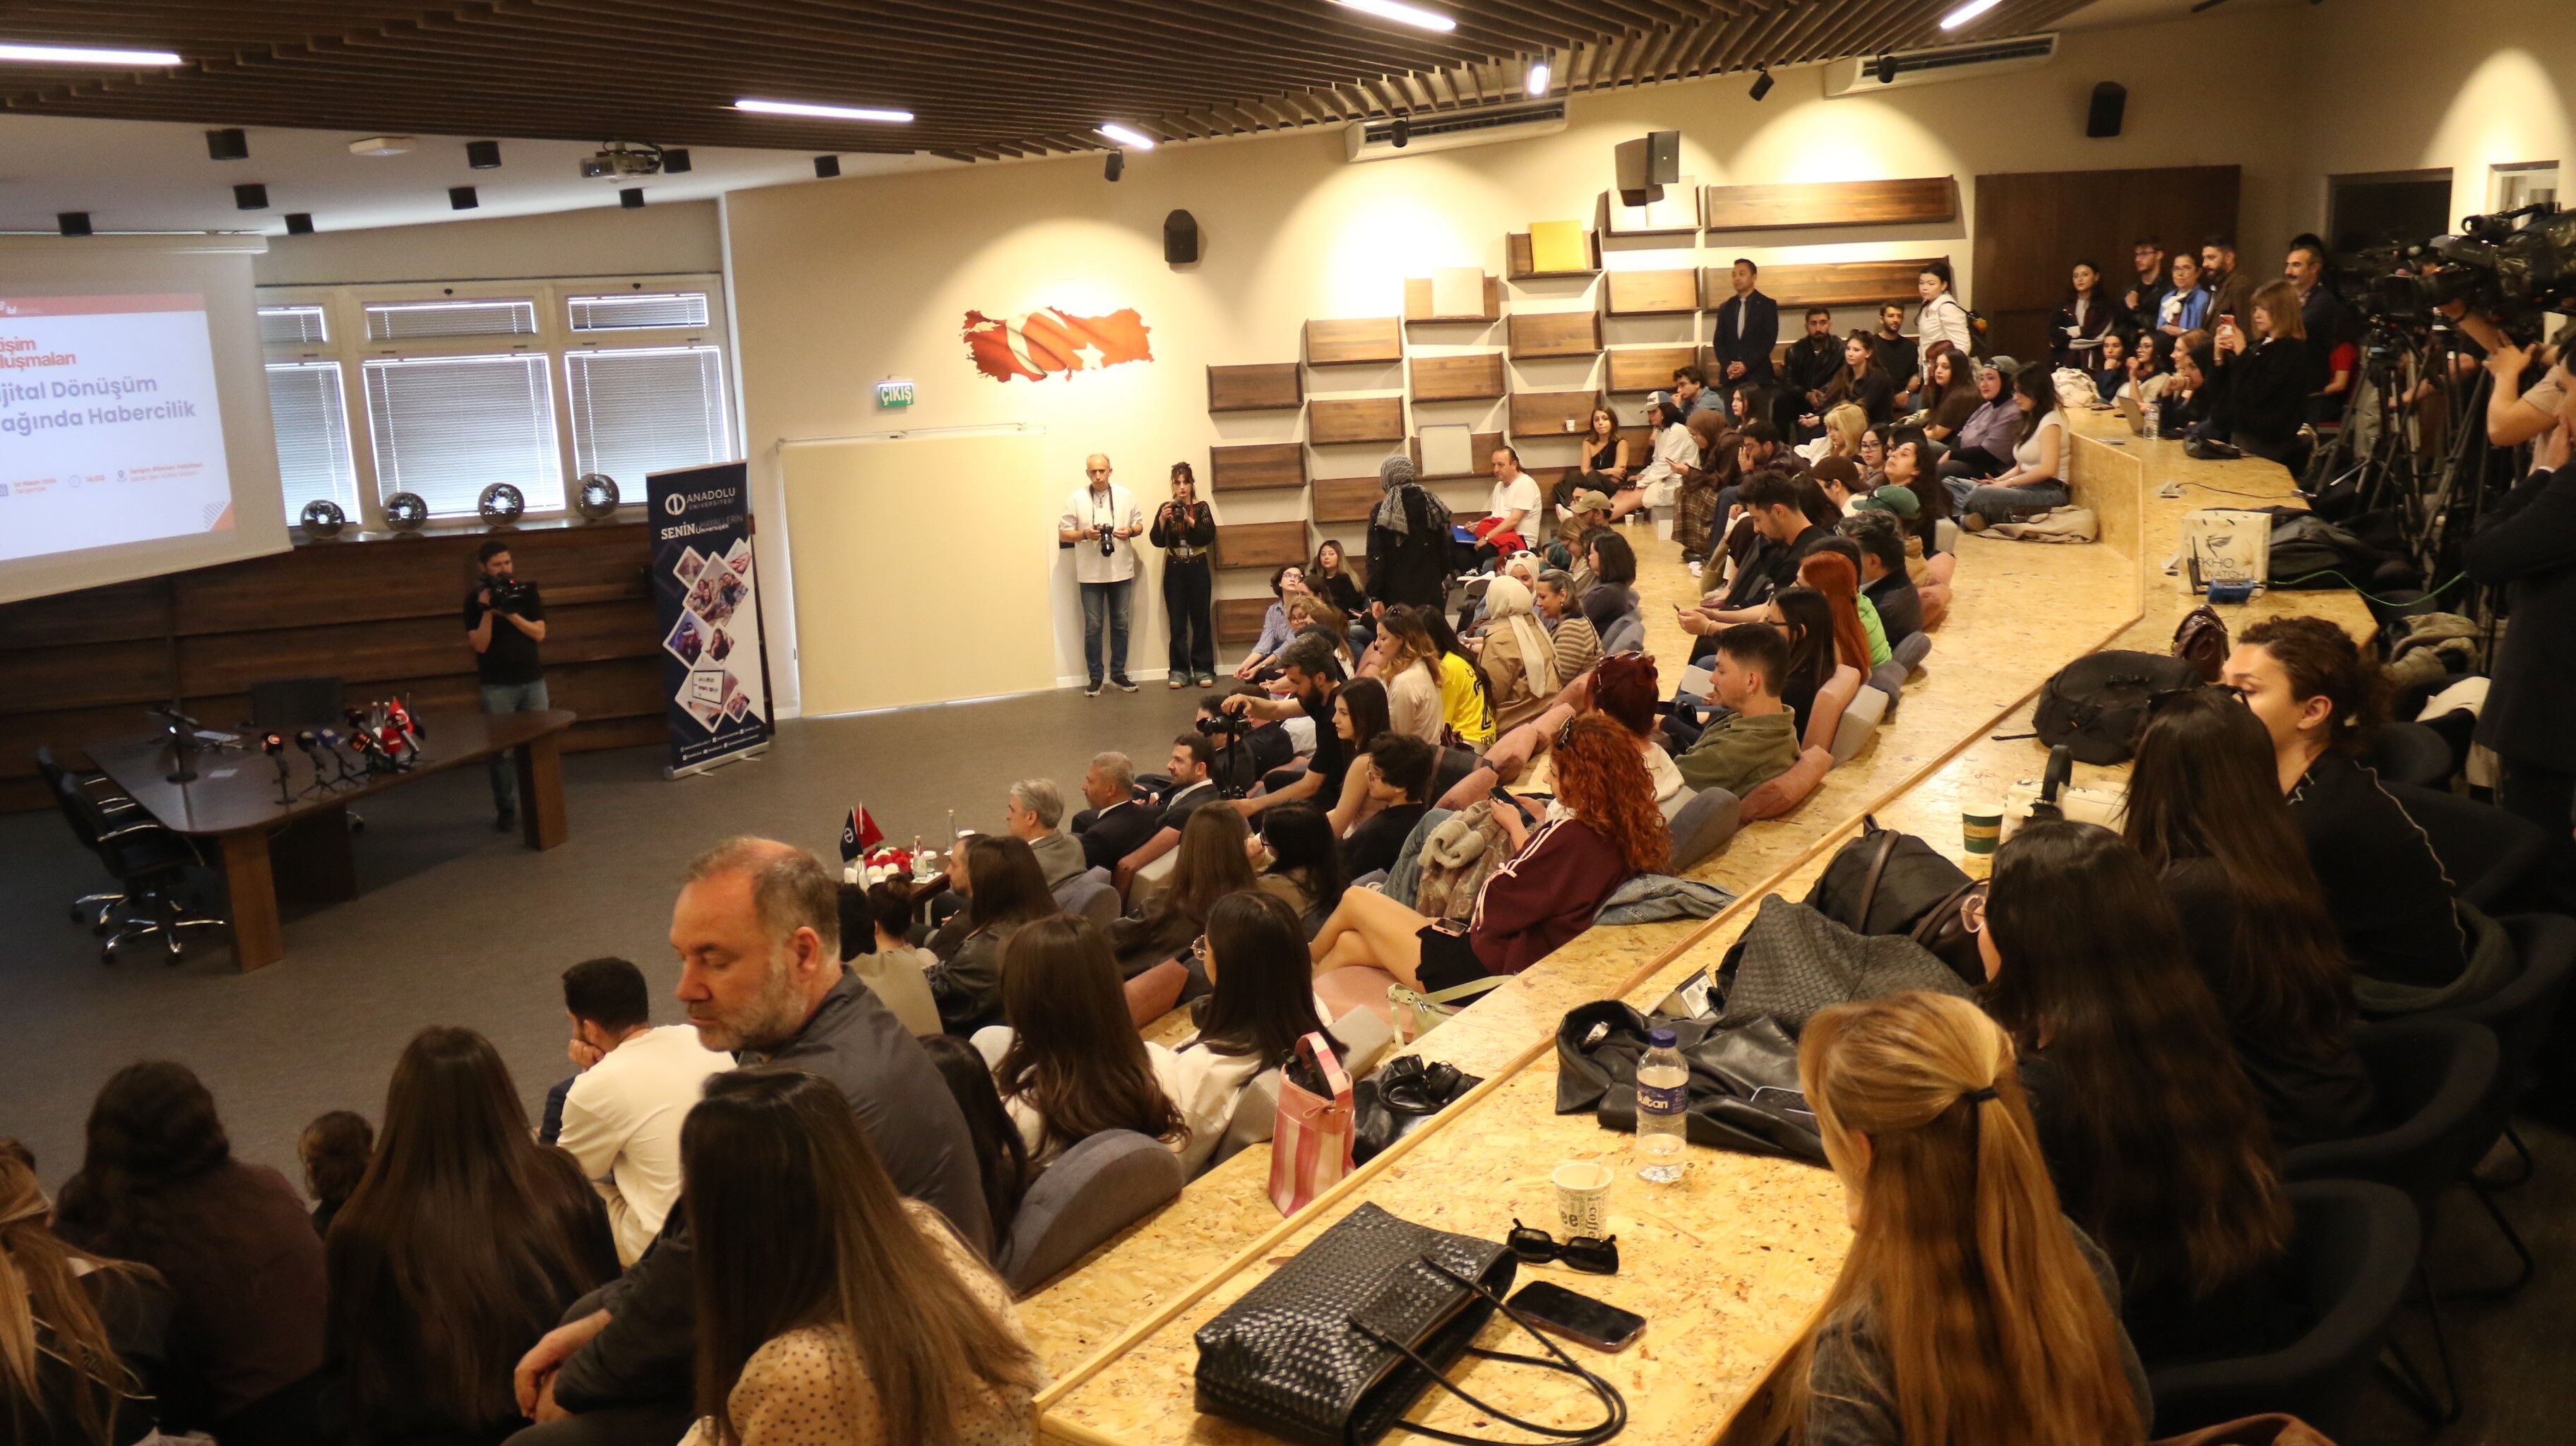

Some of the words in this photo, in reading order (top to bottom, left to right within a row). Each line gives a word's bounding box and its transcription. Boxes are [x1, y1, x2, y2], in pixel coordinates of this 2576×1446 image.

[0, 382, 46, 407] jital
[51, 376, 157, 400] Dönüşüm
[881, 386, 912, 405] ÇIKIŞ
[88, 400, 196, 424] Habercilik
[686, 487, 736, 503] ANADOLU
[660, 522, 696, 540] SENİN
